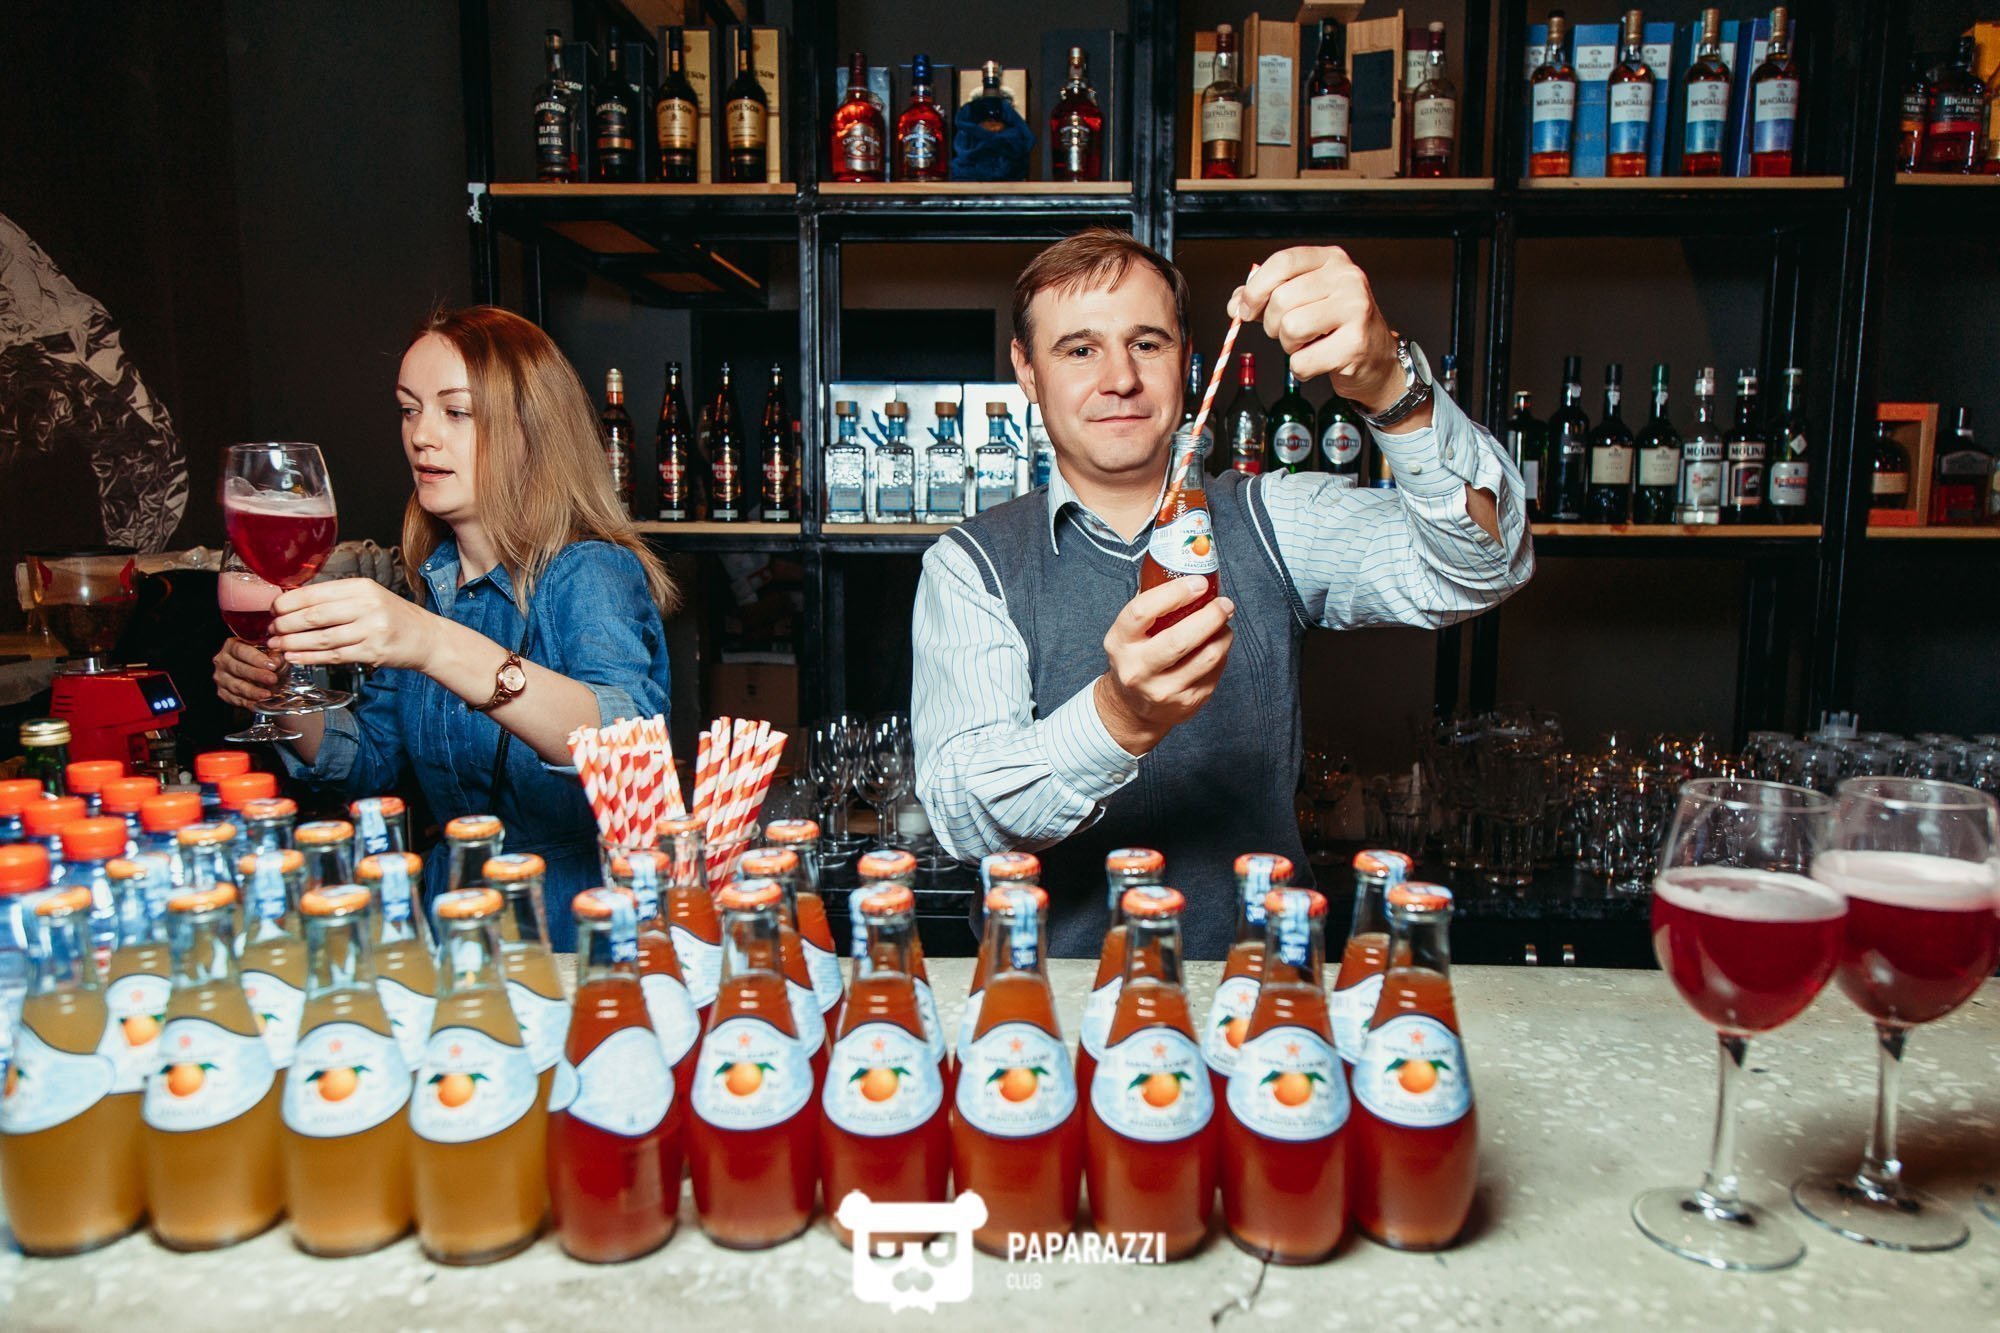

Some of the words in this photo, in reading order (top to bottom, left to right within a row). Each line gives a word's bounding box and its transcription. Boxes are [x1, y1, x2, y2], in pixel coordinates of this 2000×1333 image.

[534, 101, 567, 115] JAMESON
[597, 102, 629, 115] JAMESON
[1278, 439, 1309, 448] MARTINI
[1327, 439, 1358, 448] MARTINI
[1686, 445, 1720, 457] MOLINA
